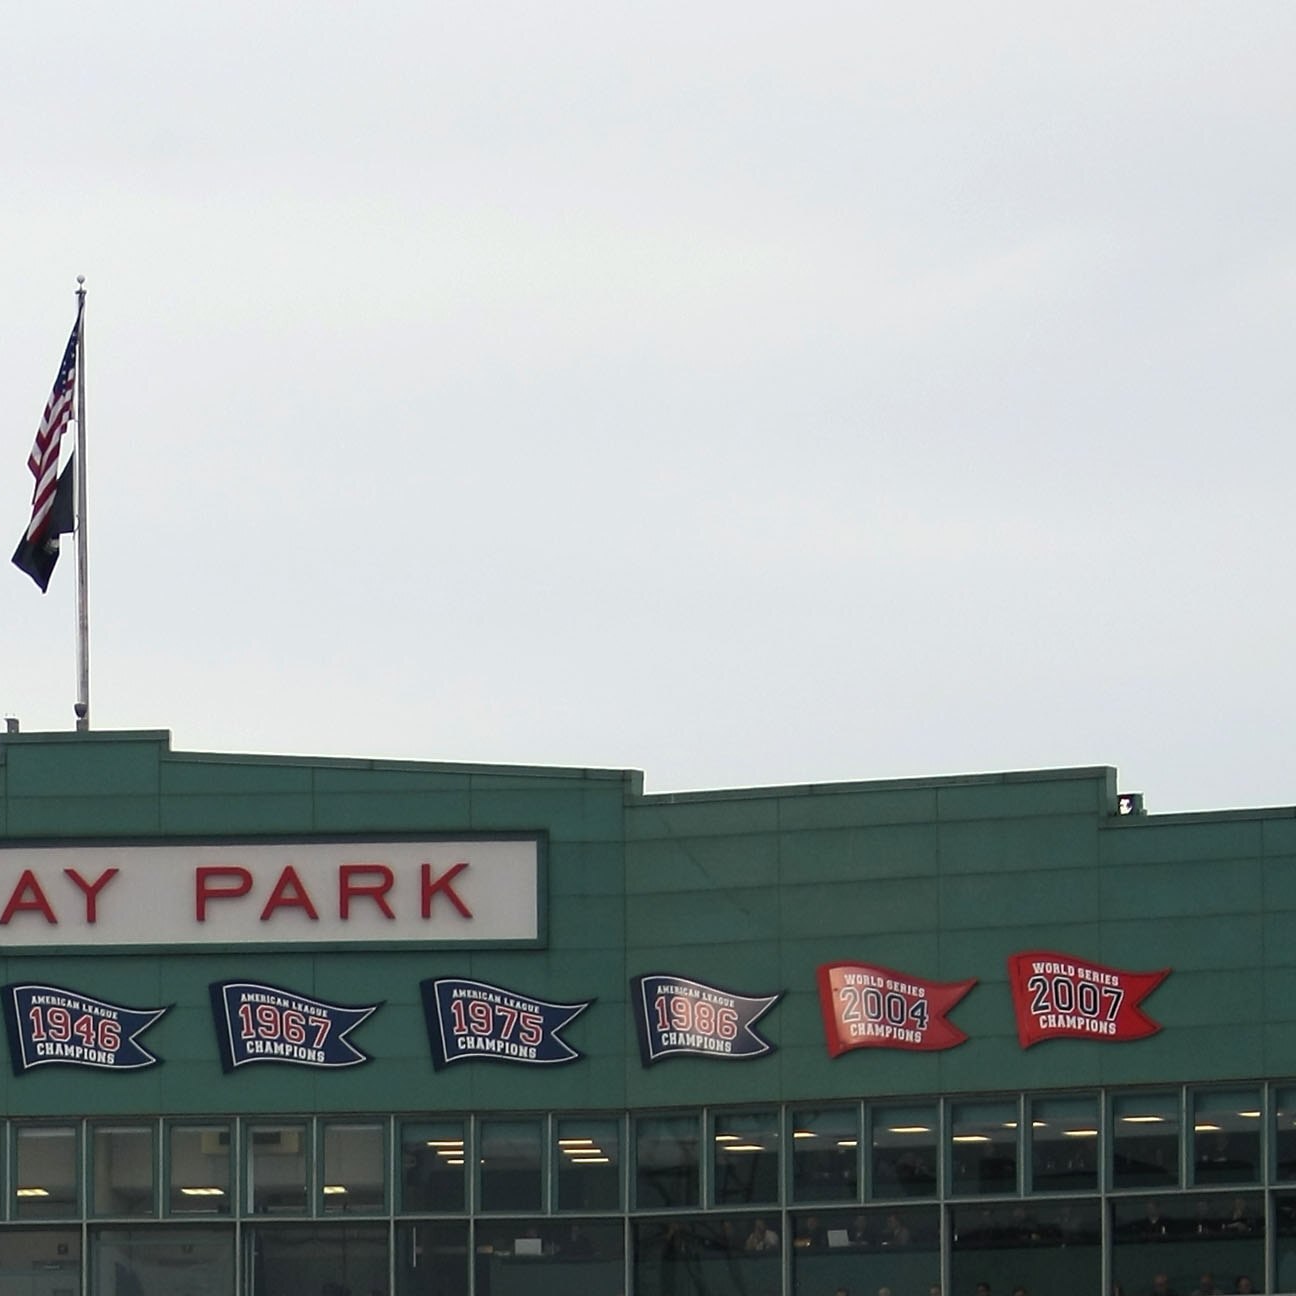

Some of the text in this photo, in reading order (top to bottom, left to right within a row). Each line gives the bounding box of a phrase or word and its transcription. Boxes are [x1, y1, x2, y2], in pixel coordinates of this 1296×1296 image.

[196, 863, 473, 922] PARK
[844, 973, 926, 998] WORLD SERIES
[1032, 962, 1119, 986] WORLD SERIES
[30, 994, 119, 1021] AMERICAN LEAGUE
[240, 992, 329, 1019] AMERICAN LEAGUE
[452, 987, 541, 1014] AMERICAN LEAGUE
[656, 984, 735, 1008] AMERICAN LEAGUE
[840, 986, 930, 1031] 2004
[1027, 975, 1125, 1021] 2007
[29, 1004, 121, 1052] 1946
[239, 1002, 332, 1049] 1967
[449, 997, 544, 1045] 1975
[654, 995, 740, 1041] 1986
[1039, 1014, 1117, 1036] CHAMPIONS
[660, 1031, 733, 1053] CHAMPIONS
[849, 1021, 923, 1043] CHAMPIONS
[36, 1041, 116, 1066] CHAMPIONS
[245, 1039, 326, 1063] CHAMPIONS
[457, 1036, 538, 1060] CHAMPIONS
